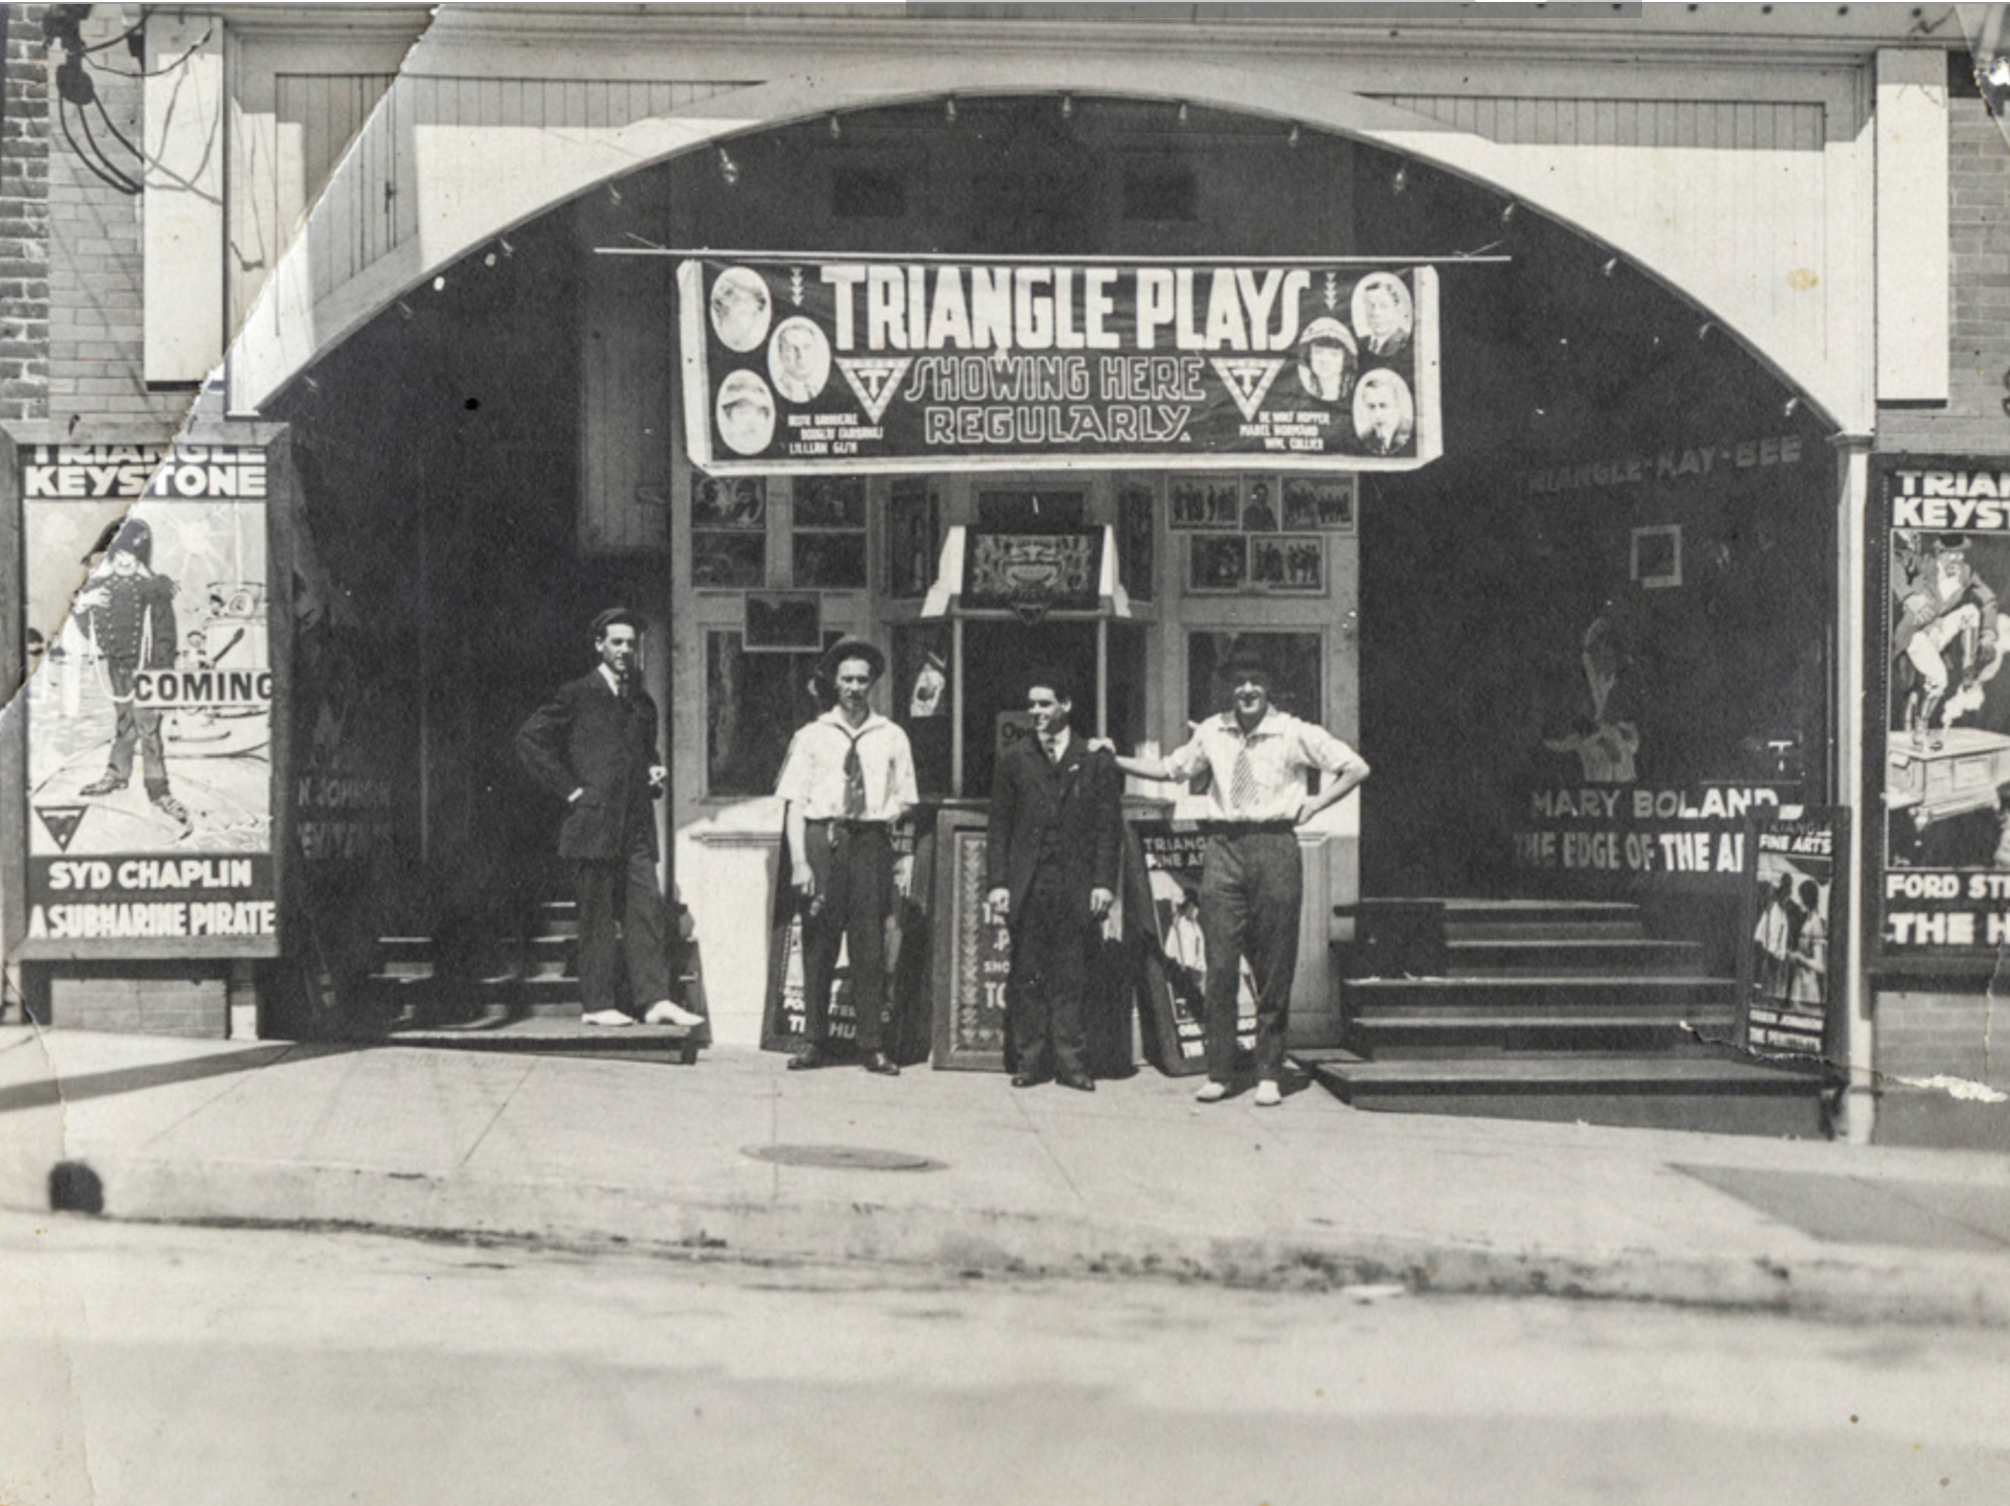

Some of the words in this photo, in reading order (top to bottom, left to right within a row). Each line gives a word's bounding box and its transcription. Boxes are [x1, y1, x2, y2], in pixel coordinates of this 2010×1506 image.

[821, 265, 1120, 350] TRIANGLE
[1136, 267, 1310, 351] PLAYS
[904, 356, 1089, 401] SHOWING
[1100, 355, 1206, 401] HERE
[1239, 424, 1271, 437] MABEL
[1290, 437, 1324, 452] COLLIER
[25, 465, 266, 496] KEYSTONE
[135, 673, 273, 701] COMING
[1532, 789, 1620, 818] MARY
[1562, 833, 1621, 869] EDGE
[1625, 833, 1655, 870] OF
[1659, 833, 1711, 871] THE
[1759, 834, 1790, 851] FINE
[1791, 836, 1832, 855] ARTS
[49, 862, 111, 889] SYD
[117, 860, 252, 889] CHAPLIN
[1886, 873, 1960, 899] FORD
[28, 905, 49, 938] A
[49, 903, 187, 938] SUBMARINE
[190, 901, 276, 936] PIRATE
[1888, 912, 1975, 944] THE
